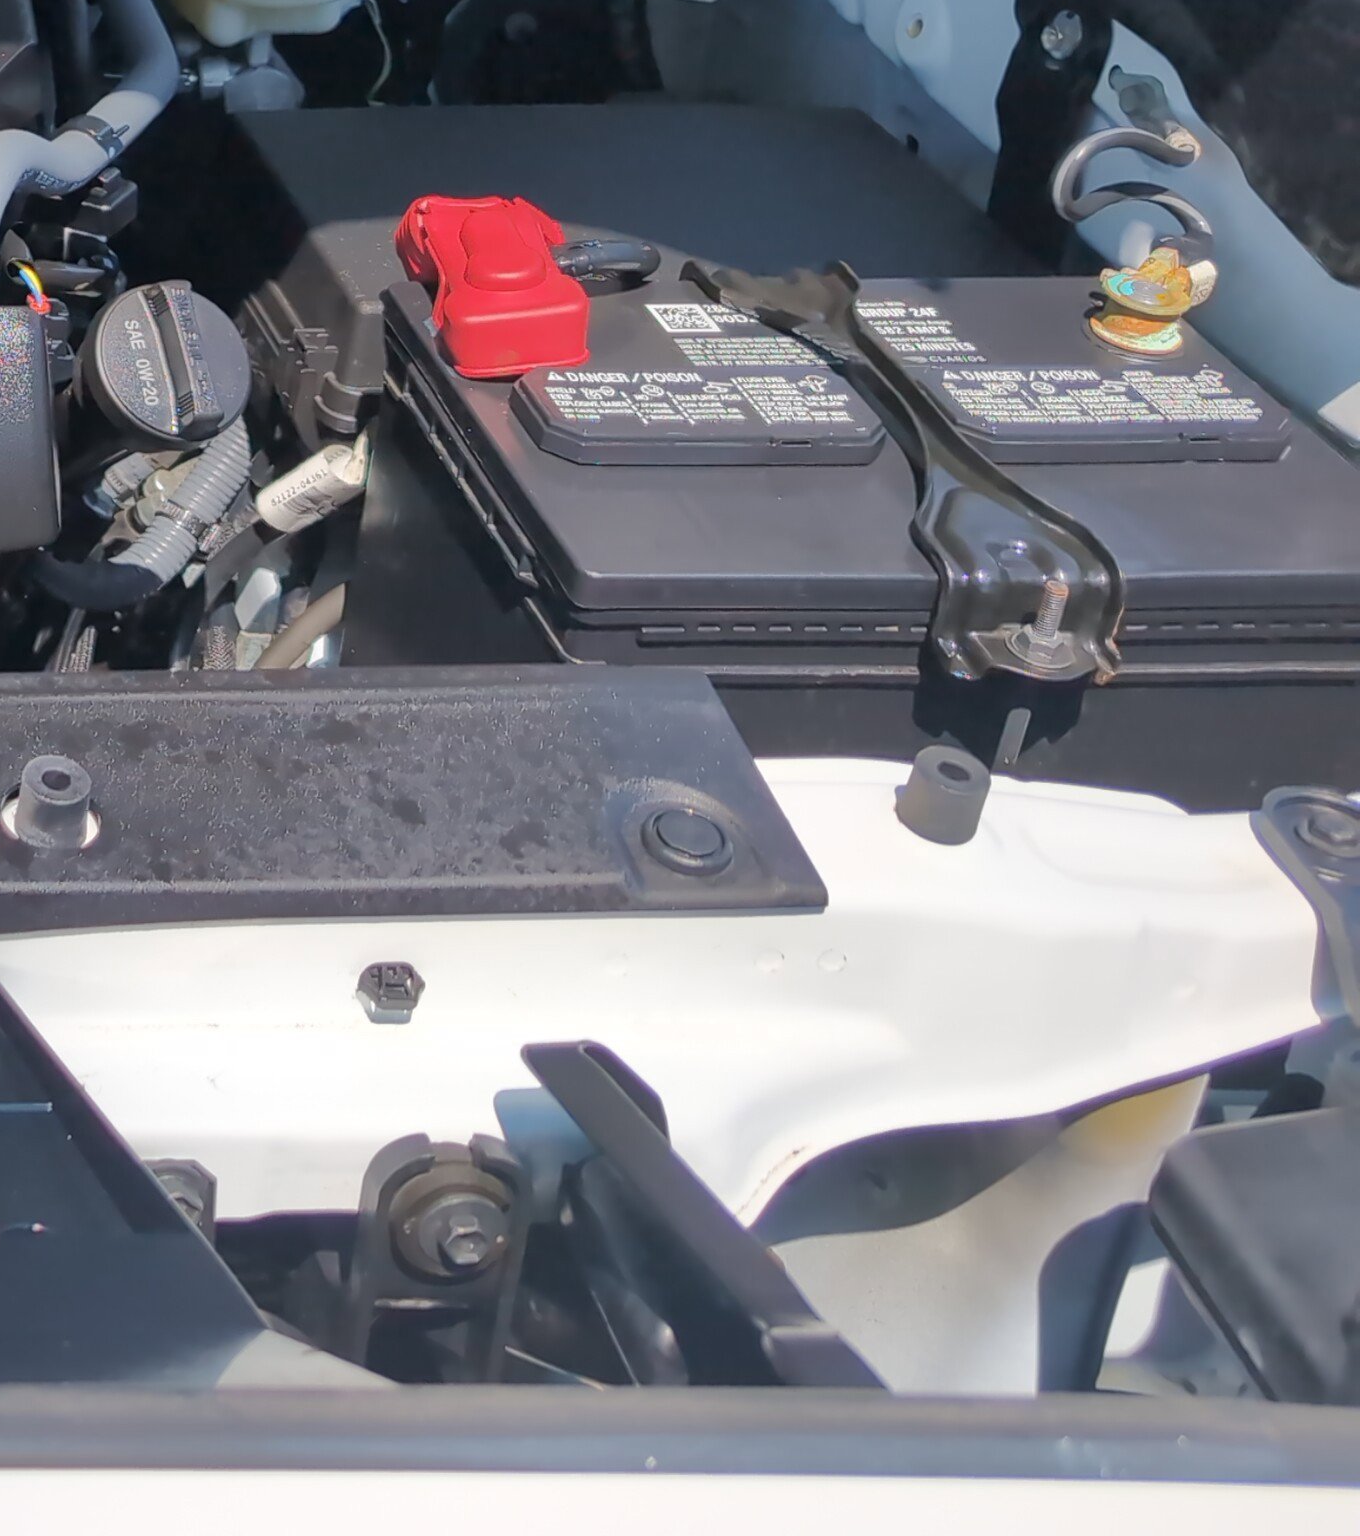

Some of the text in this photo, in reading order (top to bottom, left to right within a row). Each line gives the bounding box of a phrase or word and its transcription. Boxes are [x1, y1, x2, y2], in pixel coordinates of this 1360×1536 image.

[857, 307, 938, 317] GROUP 24F
[124, 320, 146, 350] SAE
[874, 326, 952, 335] 582 AMPS
[891, 341, 977, 352] 125 MINUTES
[564, 372, 630, 383] DANGER
[641, 372, 703, 383] POISON
[960, 370, 1028, 381] DANGER
[1037, 370, 1101, 381] POISON
[135, 359, 159, 406] 0W-20
